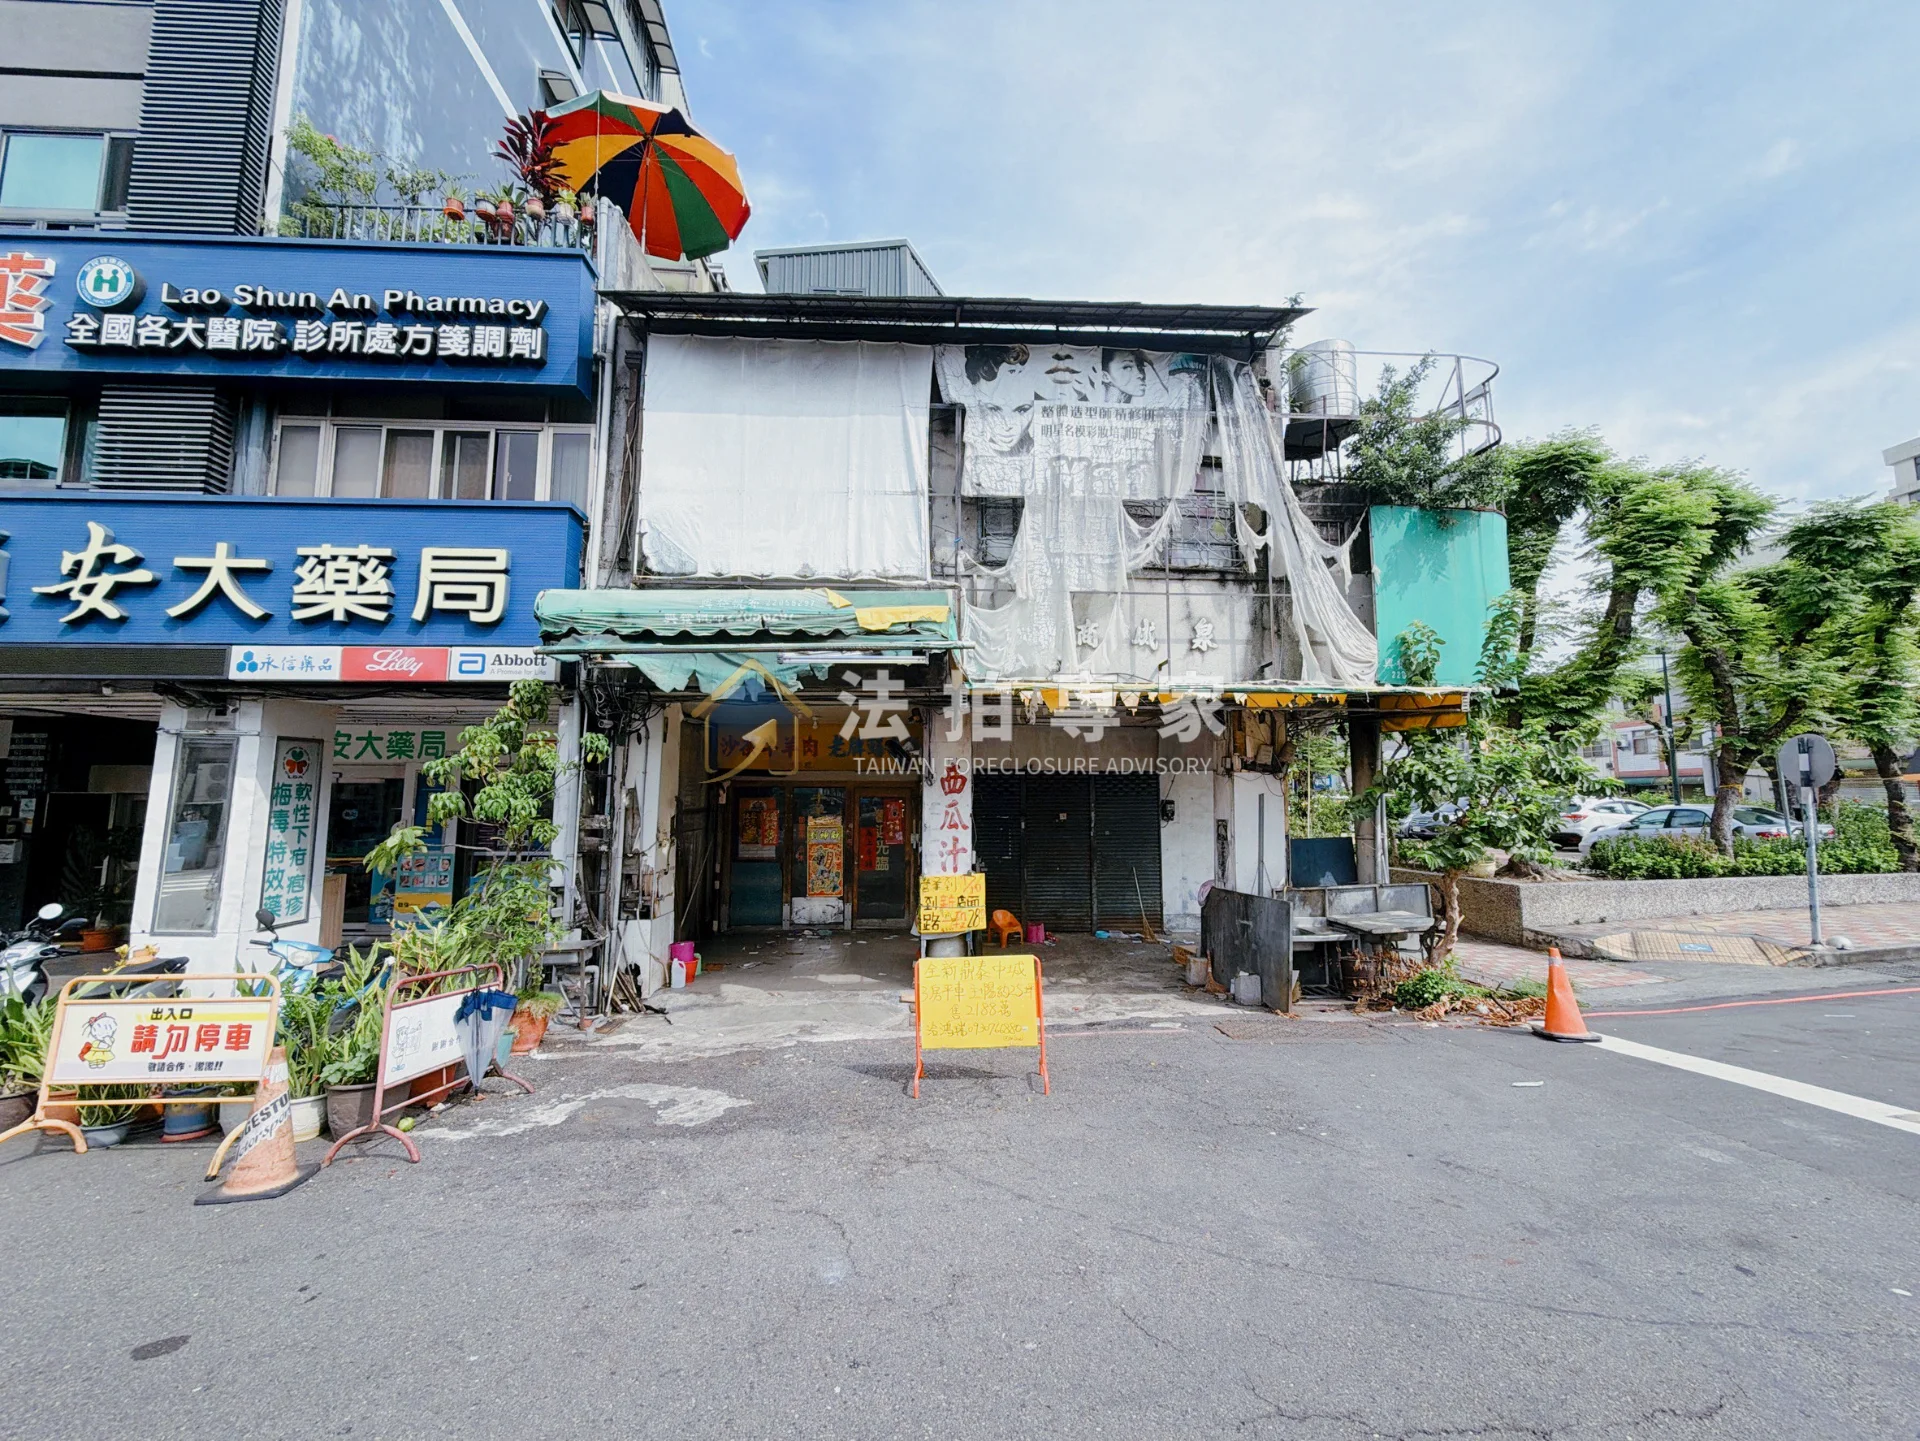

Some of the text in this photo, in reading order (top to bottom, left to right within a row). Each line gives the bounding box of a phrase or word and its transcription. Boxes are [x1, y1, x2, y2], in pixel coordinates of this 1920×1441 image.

[161, 282, 544, 320] Lao Shun An Pharmacy
[32, 520, 510, 624] 安大藥局
[365, 649, 424, 676] Lilly
[490, 652, 548, 667] Abbott
[333, 729, 446, 761] 安大藥局
[938, 763, 969, 874] 西瓜汁
[150, 1007, 193, 1021] 出入口
[130, 1023, 253, 1060] 請勿停車
